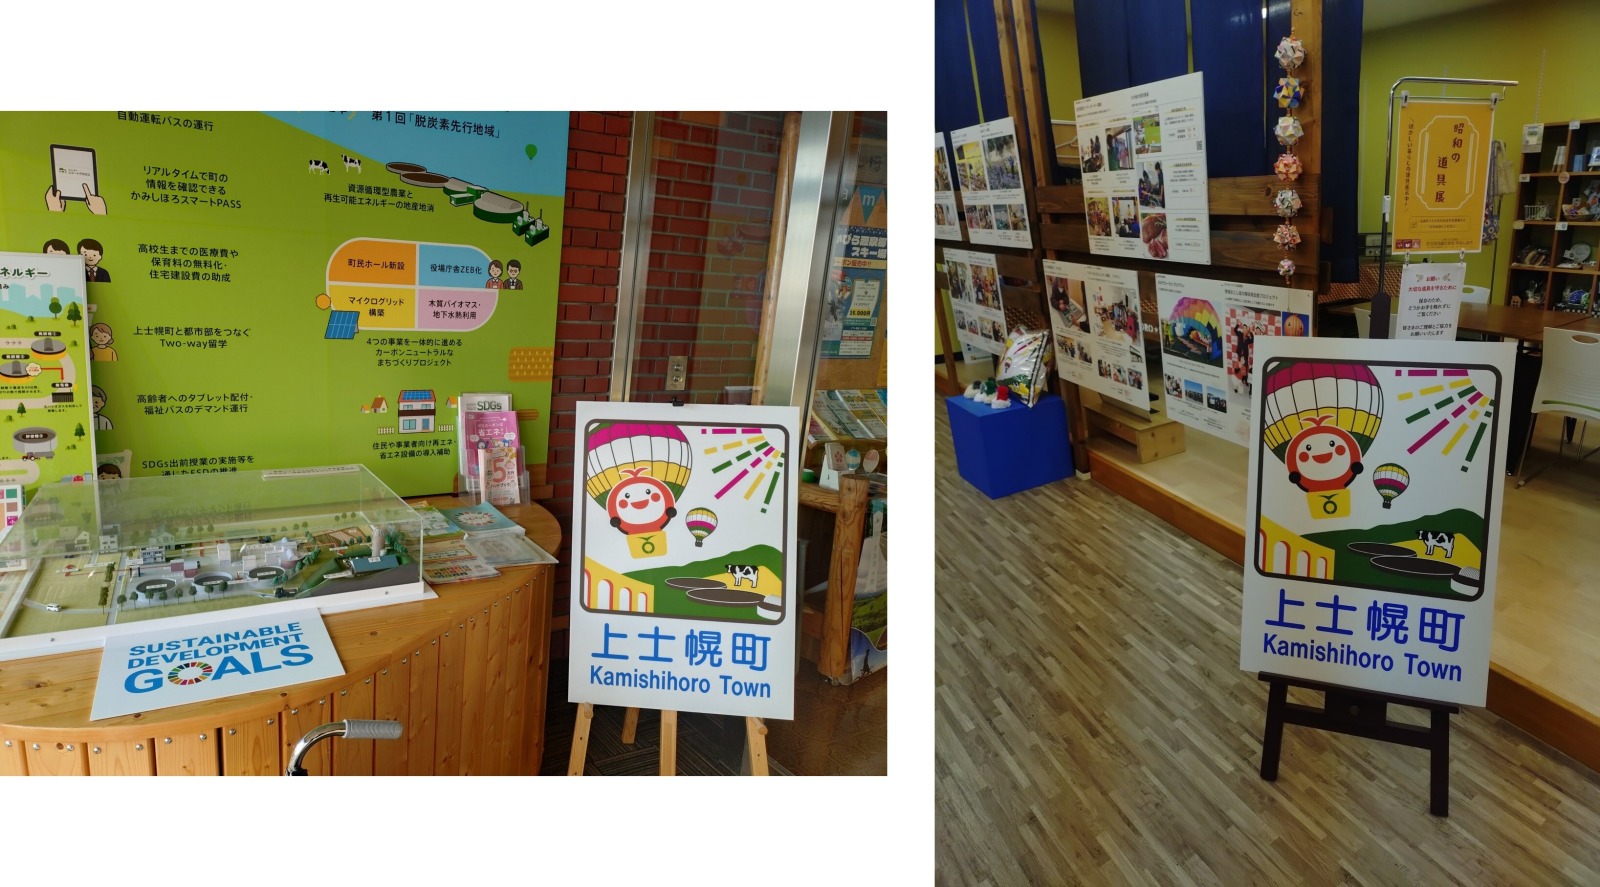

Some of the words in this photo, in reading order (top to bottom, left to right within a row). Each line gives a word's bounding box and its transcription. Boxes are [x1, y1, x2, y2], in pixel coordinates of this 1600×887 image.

[1451, 123, 1464, 163] 昭和の
[143, 165, 228, 182] リアルタイムで町の
[1434, 156, 1448, 203] 道具展
[145, 179, 226, 195] 情報を確認できる
[347, 183, 413, 199] 資源循環型農業と
[130, 191, 241, 209] かみしほろスマートPASS
[324, 192, 435, 212] 再生可能エネルギーの地産地消
[138, 243, 239, 259] 高校生までの医療費や
[0, 267, 48, 277] ネルギー
[348, 258, 405, 271] 町民ホール新設
[430, 263, 483, 275] 役場庁舎ZEB化
[149, 269, 231, 283] 住宅建設費の助成
[348, 296, 405, 307] マイクログリッド
[368, 308, 385, 317] 構築
[433, 310, 477, 320] 地下水熱利用
[133, 326, 251, 337] 上士幌町と都市部をつなぐ
[160, 339, 228, 349] Two-way留学
[366, 338, 462, 347] 4つの事業を一体的に進める
[375, 348, 454, 357] カーボンニュートラルな
[377, 358, 451, 367] まちづくりプロジェクト
[144, 404, 248, 415] 福祉バスのデマンド運行
[477, 400, 502, 411] SDGs
[379, 448, 450, 460] 省エネ設備の導入補助
[142, 455, 254, 469] SDGs出前授業の実施等を
[492, 457, 507, 483] 5
[1264, 588, 1466, 653] 上士幌町
[128, 622, 302, 657] SUSTAINABLE
[591, 622, 771, 672] 上士幌町
[127, 632, 304, 670] DEVELOPMENT
[1263, 632, 1394, 672] Kamishihoro
[1403, 652, 1462, 682] Town
[124, 644, 314, 694] GOALS
[590, 665, 711, 693] Kamishihoro
[719, 674, 771, 698] Town
